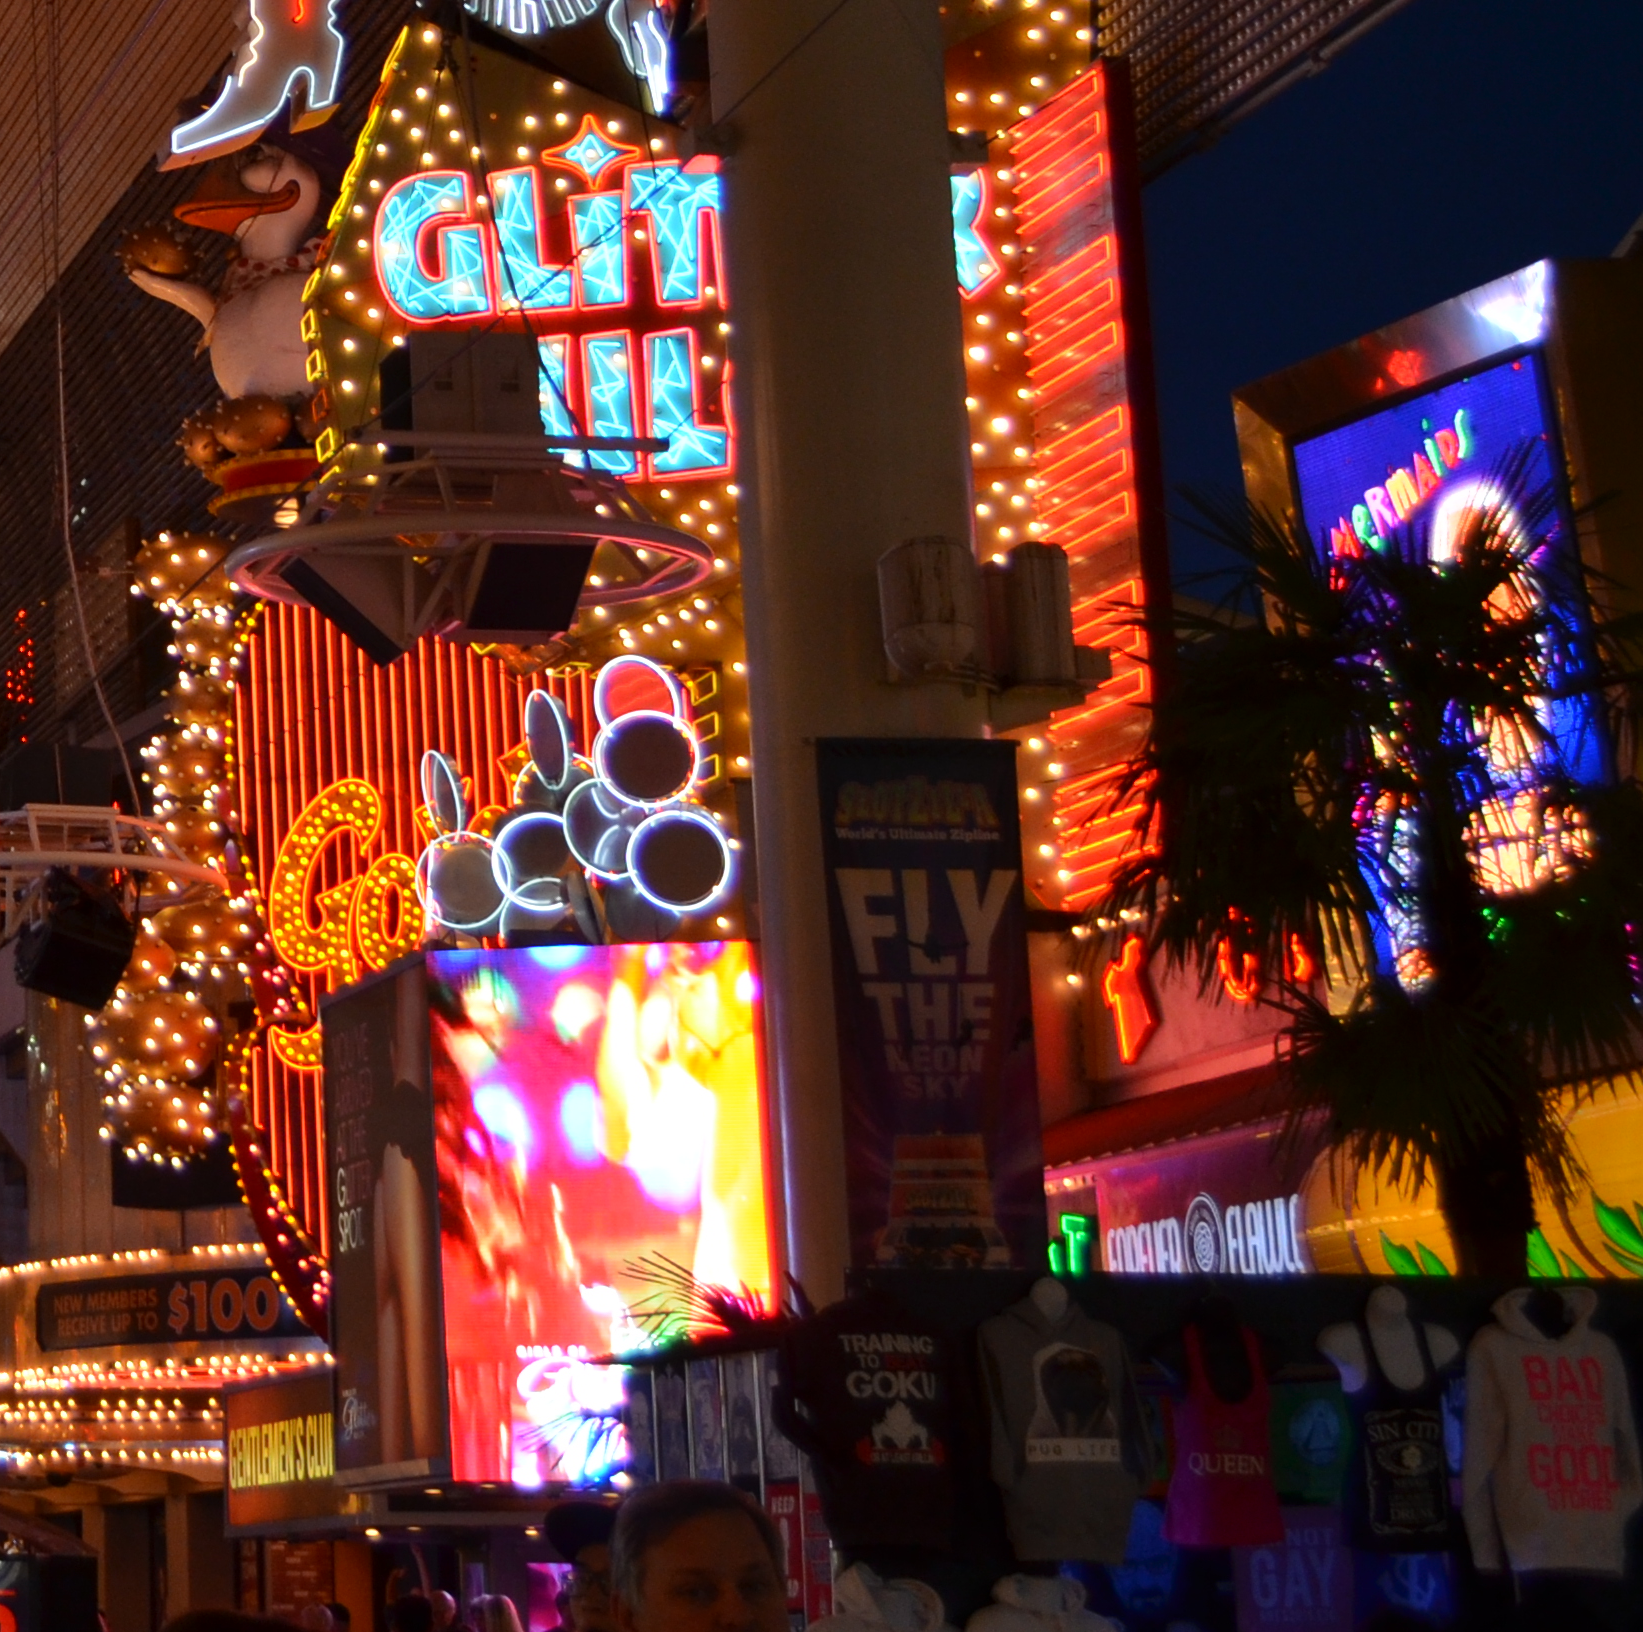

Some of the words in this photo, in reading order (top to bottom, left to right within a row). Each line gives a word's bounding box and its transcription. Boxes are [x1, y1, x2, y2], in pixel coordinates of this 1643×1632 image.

[834, 827, 886, 840] World's
[889, 828, 947, 840] Ultimate
[949, 828, 1001, 843] Zipline
[834, 868, 1017, 976] FLY
[861, 981, 995, 1040] THE
[884, 1043, 985, 1074] NEON
[902, 1074, 970, 1099] SKY
[53, 1294, 86, 1314] NEW
[87, 1287, 159, 1312] MEMBERS
[167, 1276, 280, 1335] $100
[57, 1316, 109, 1338] RECEIVE
[111, 1315, 131, 1334] UP
[135, 1312, 159, 1331] TO
[838, 1332, 935, 1355] TRAINING
[856, 1353, 880, 1369] TO
[845, 1370, 936, 1400] GOKU
[1521, 1355, 1604, 1401] BAD
[1367, 1421, 1401, 1443] SIN
[229, 1417, 306, 1490] GENTLEMEN'S
[1027, 1444, 1063, 1456] PUG
[1077, 1444, 1119, 1456] LIFE
[1188, 1451, 1265, 1475] QUEEN
[1249, 1548, 1336, 1608] GAY
